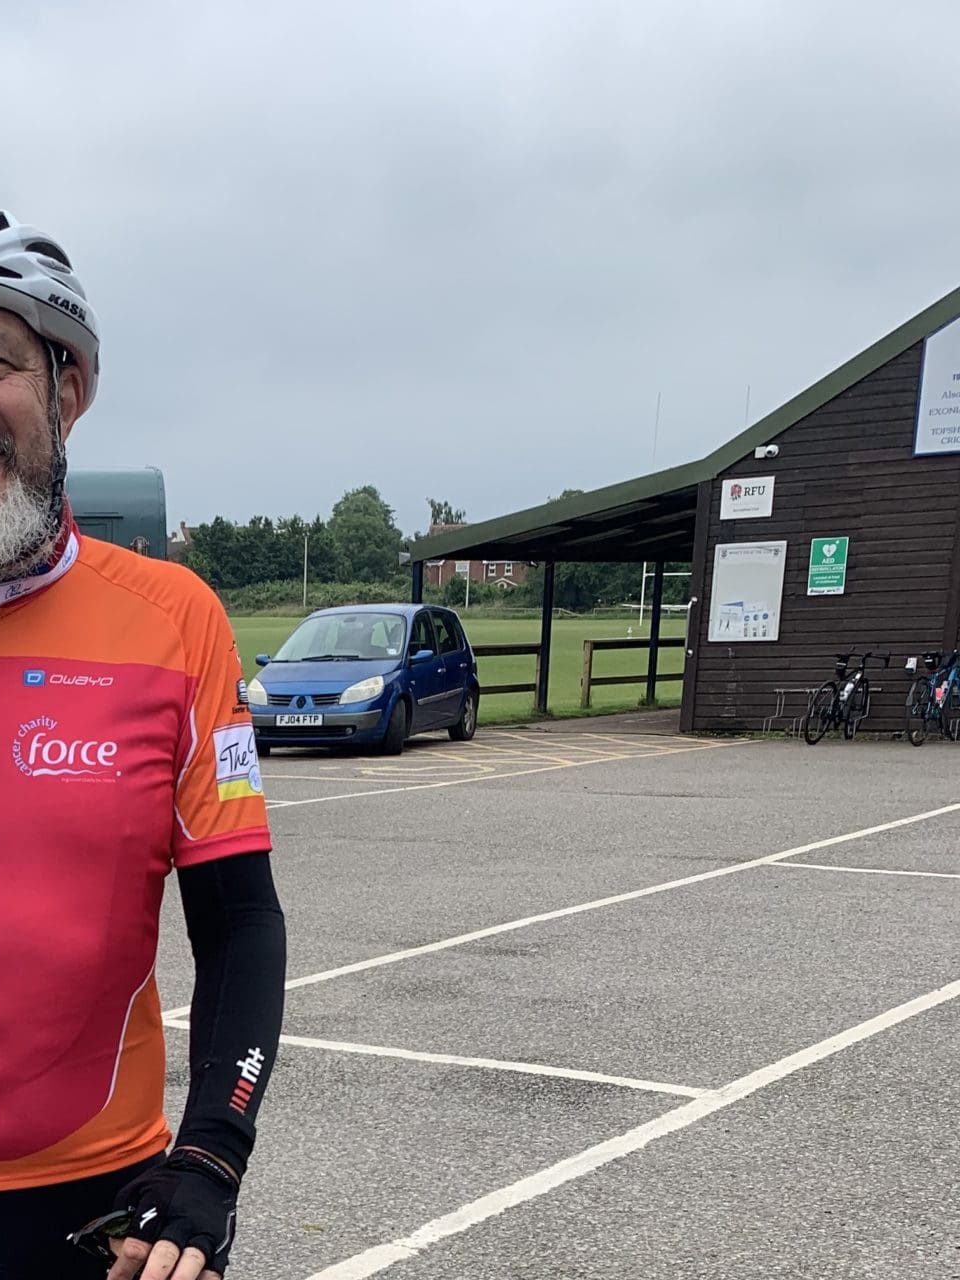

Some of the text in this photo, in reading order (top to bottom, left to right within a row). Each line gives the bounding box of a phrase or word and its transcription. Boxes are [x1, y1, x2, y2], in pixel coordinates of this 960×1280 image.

[48, 293, 87, 322] KASK
[744, 485, 766, 497] RFU
[279, 715, 319, 726] FJ04 FTP
[12, 715, 58, 777] cancer charity
[28, 732, 118, 766] force
[220, 742, 249, 773] The
